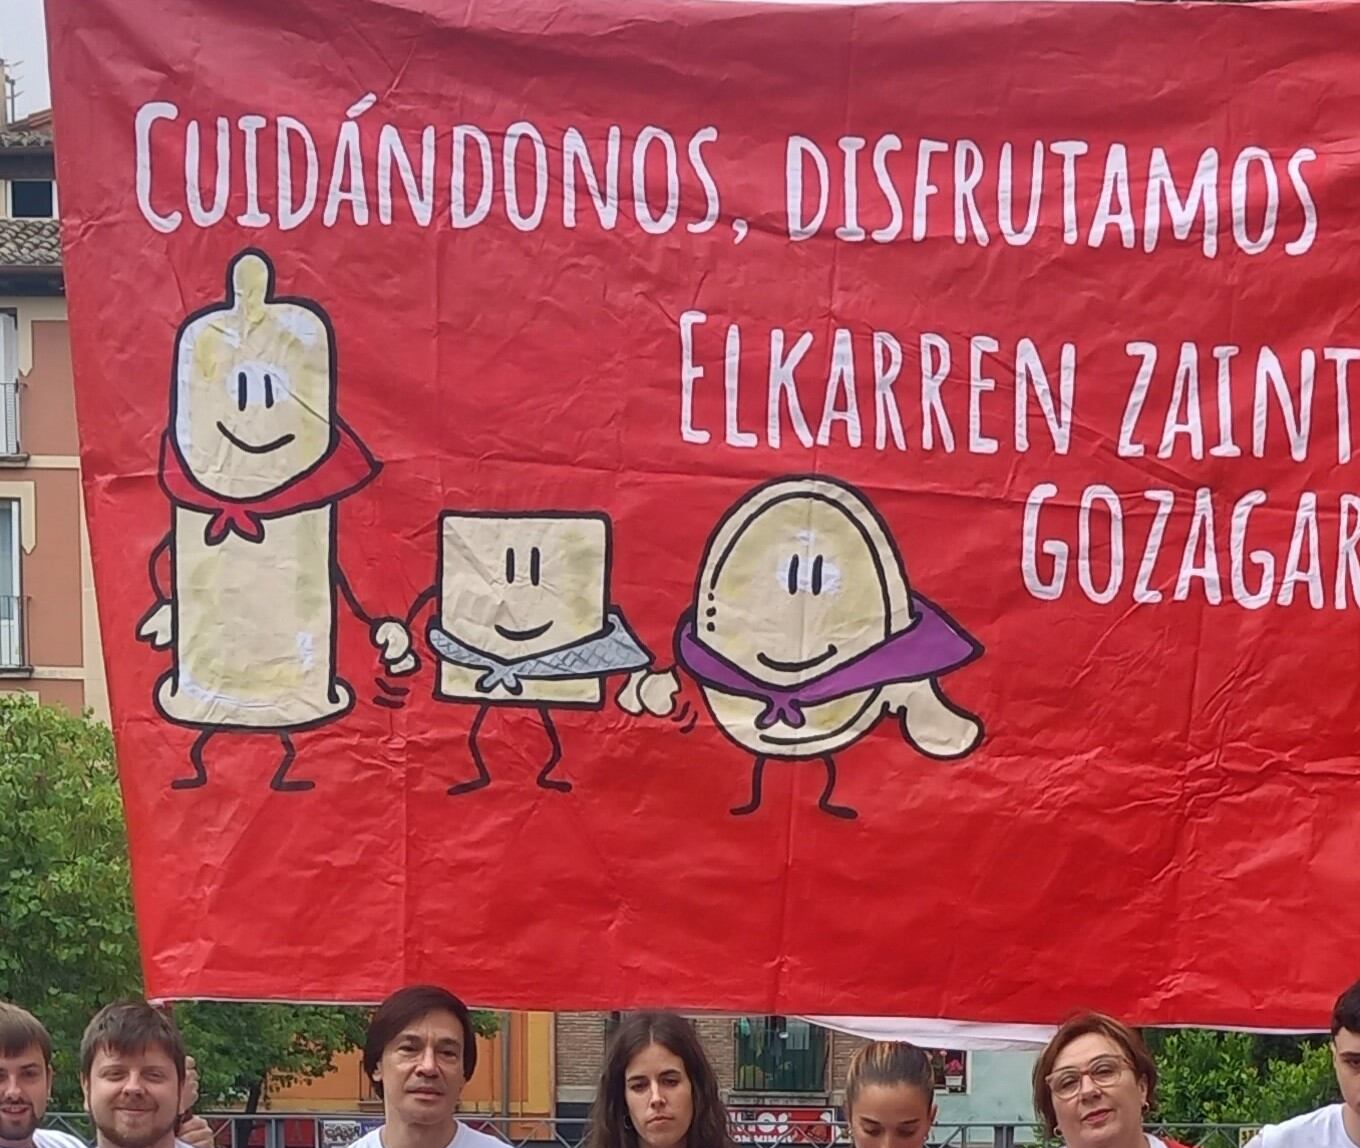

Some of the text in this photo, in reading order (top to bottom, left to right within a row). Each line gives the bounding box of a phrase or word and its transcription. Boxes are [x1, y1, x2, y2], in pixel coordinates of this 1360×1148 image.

[135, 92, 1318, 258] CUIDÁNDONOS, DISFRUTAMOS
[679, 310, 1076, 457] ELKARREN
